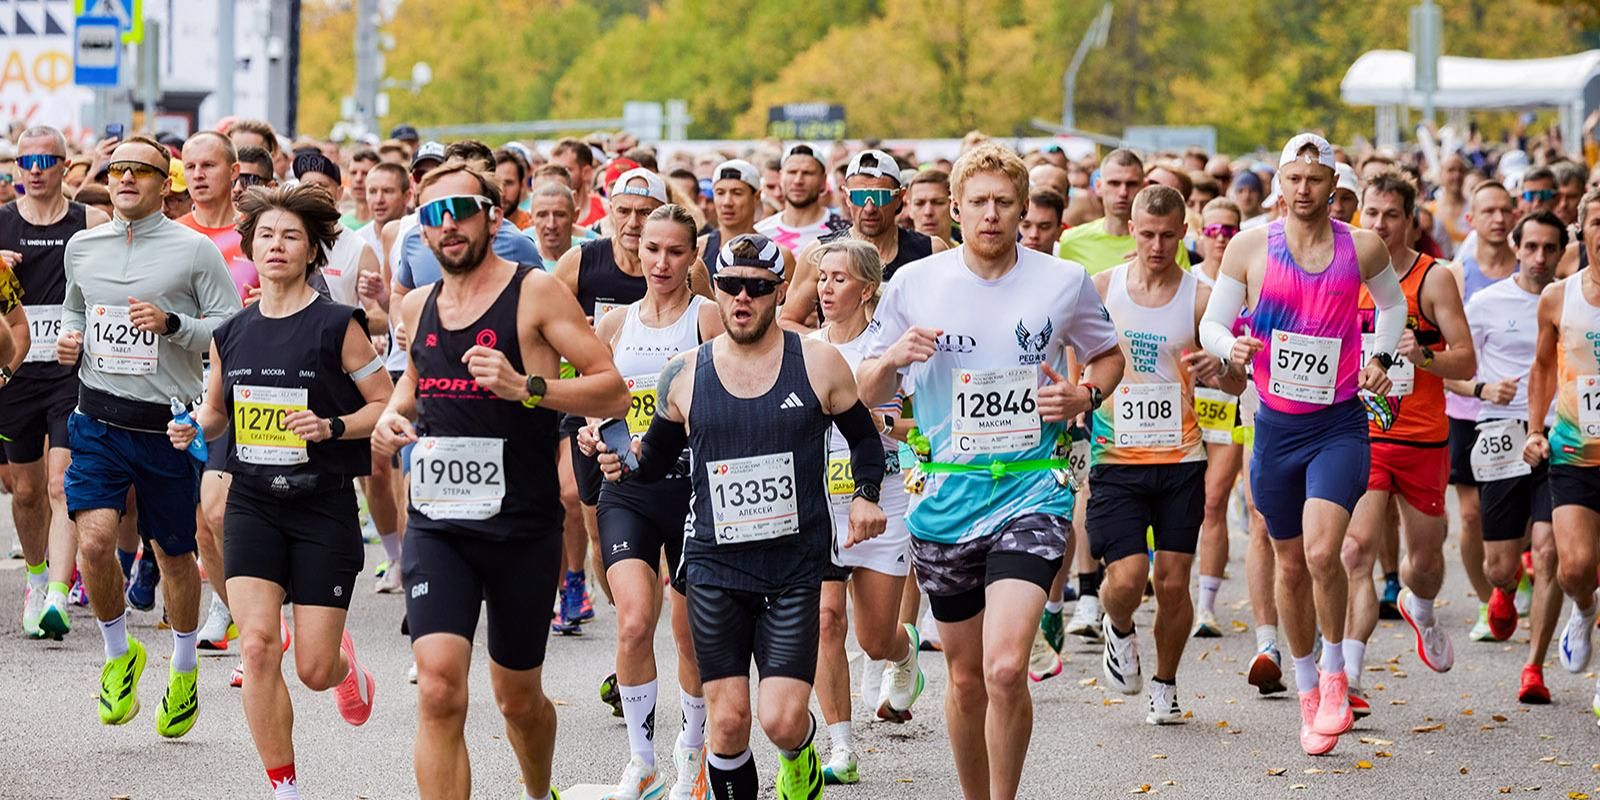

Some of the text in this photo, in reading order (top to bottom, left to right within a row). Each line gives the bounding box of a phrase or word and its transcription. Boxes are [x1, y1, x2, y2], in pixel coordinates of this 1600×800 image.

[27, 239, 46, 247] UNDER
[47, 239, 54, 247] BY
[93, 322, 155, 346] 14290
[1124, 330, 1167, 342] Golden
[1131, 340, 1158, 350] Ring
[1018, 353, 1047, 361] PEGAS
[1130, 348, 1158, 358] Ultra
[1132, 356, 1157, 366] Trail
[1277, 349, 1329, 375] 5796
[1133, 365, 1156, 373] 100
[957, 388, 1036, 418] 12846
[1122, 400, 1172, 420] 3108
[1198, 401, 1228, 421] 356
[979, 419, 1012, 428] МАКСИМ
[250, 433, 286, 441] ЕКАТЕРИНА
[1480, 434, 1513, 455] 358
[416, 458, 500, 485] 19082
[715, 475, 794, 508] 13353
[739, 506, 773, 517] АЛЕКСЕЙ
